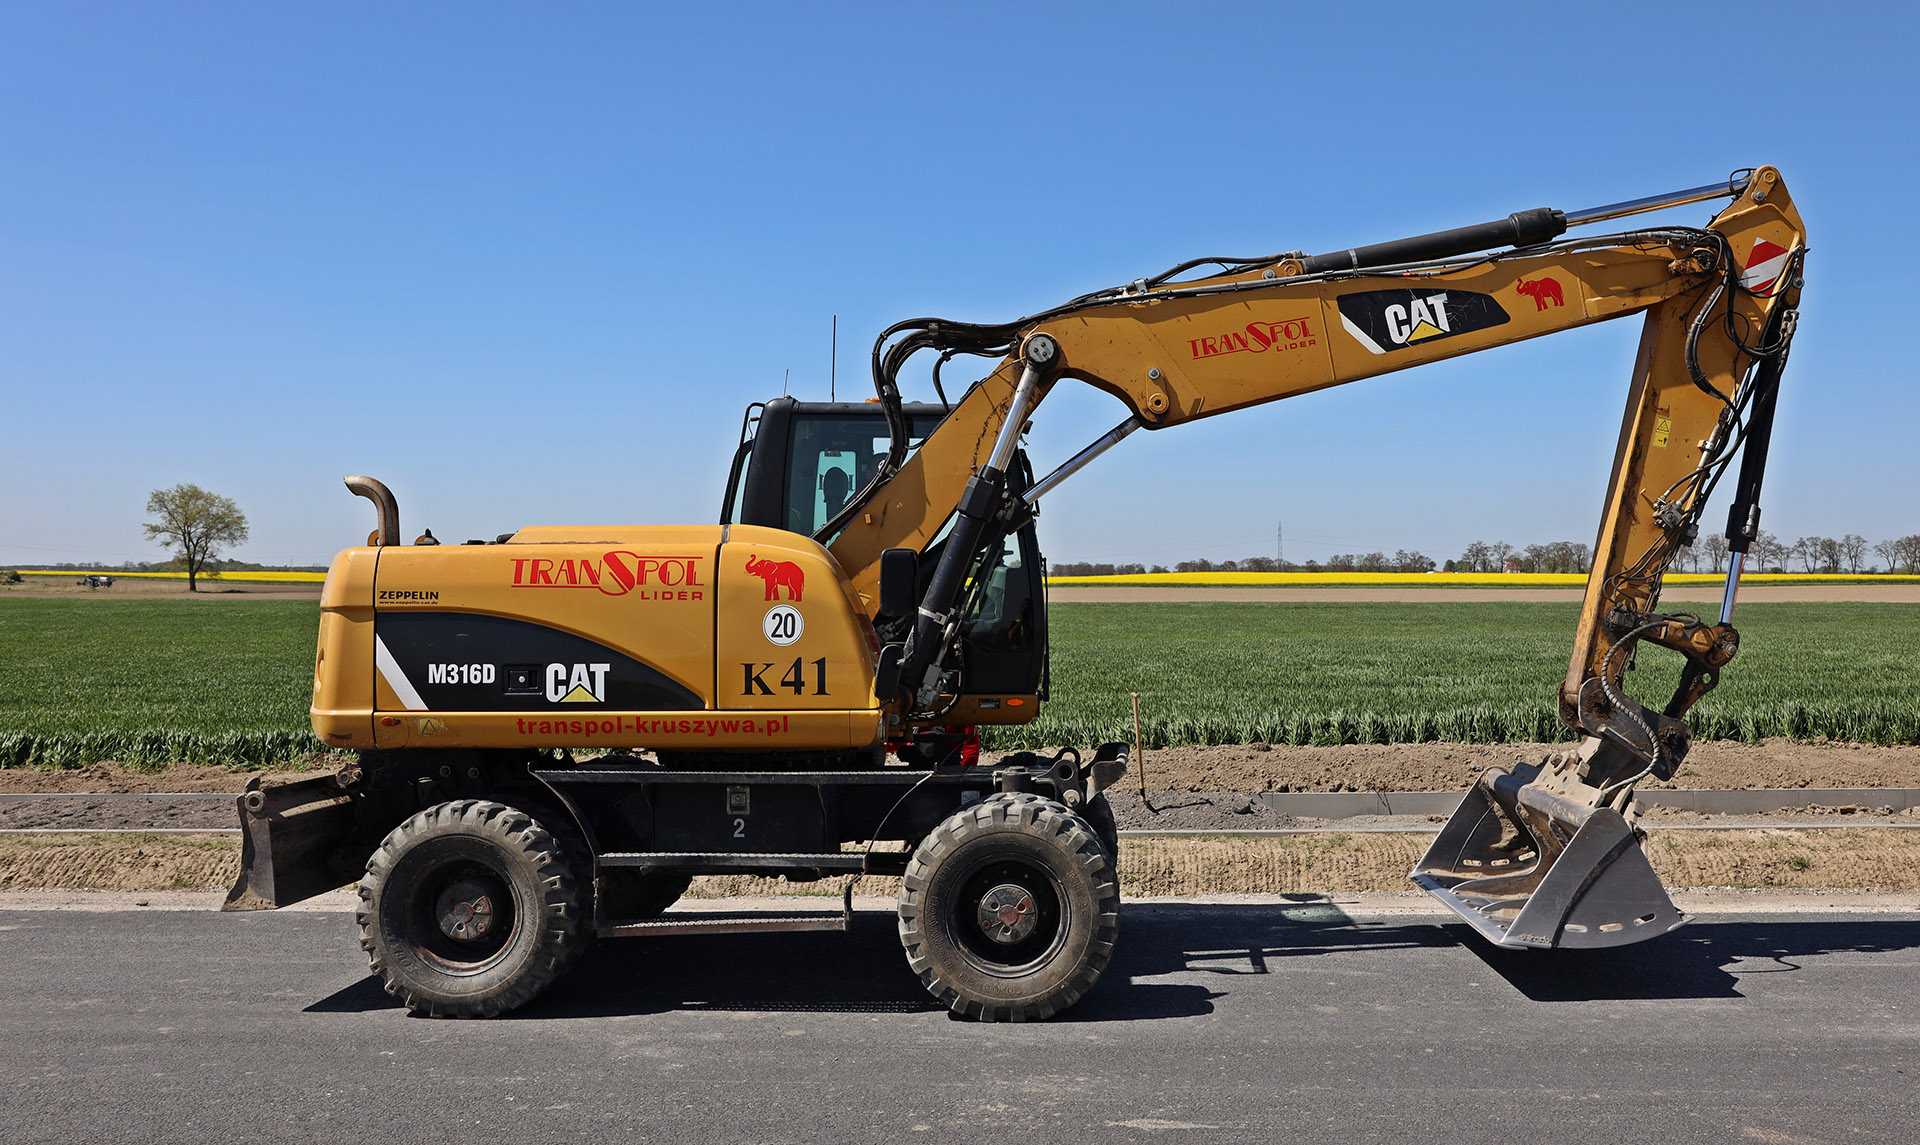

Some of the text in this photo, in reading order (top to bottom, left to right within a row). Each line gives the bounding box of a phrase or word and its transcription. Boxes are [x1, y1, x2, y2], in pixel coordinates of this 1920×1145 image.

[1385, 293, 1450, 344] CAT
[1187, 316, 1315, 360] TRANSPOL
[1276, 338, 1316, 352] LIDER
[511, 551, 704, 595] TRANSPOL
[379, 591, 439, 600] ZEPPELIN
[640, 591, 703, 600] LIDER
[771, 613, 796, 638] 20
[428, 663, 496, 684] M316D
[546, 663, 611, 702] CAT
[516, 715, 788, 736] transpol-kruszywa.pl
[733, 818, 745, 838] 2
